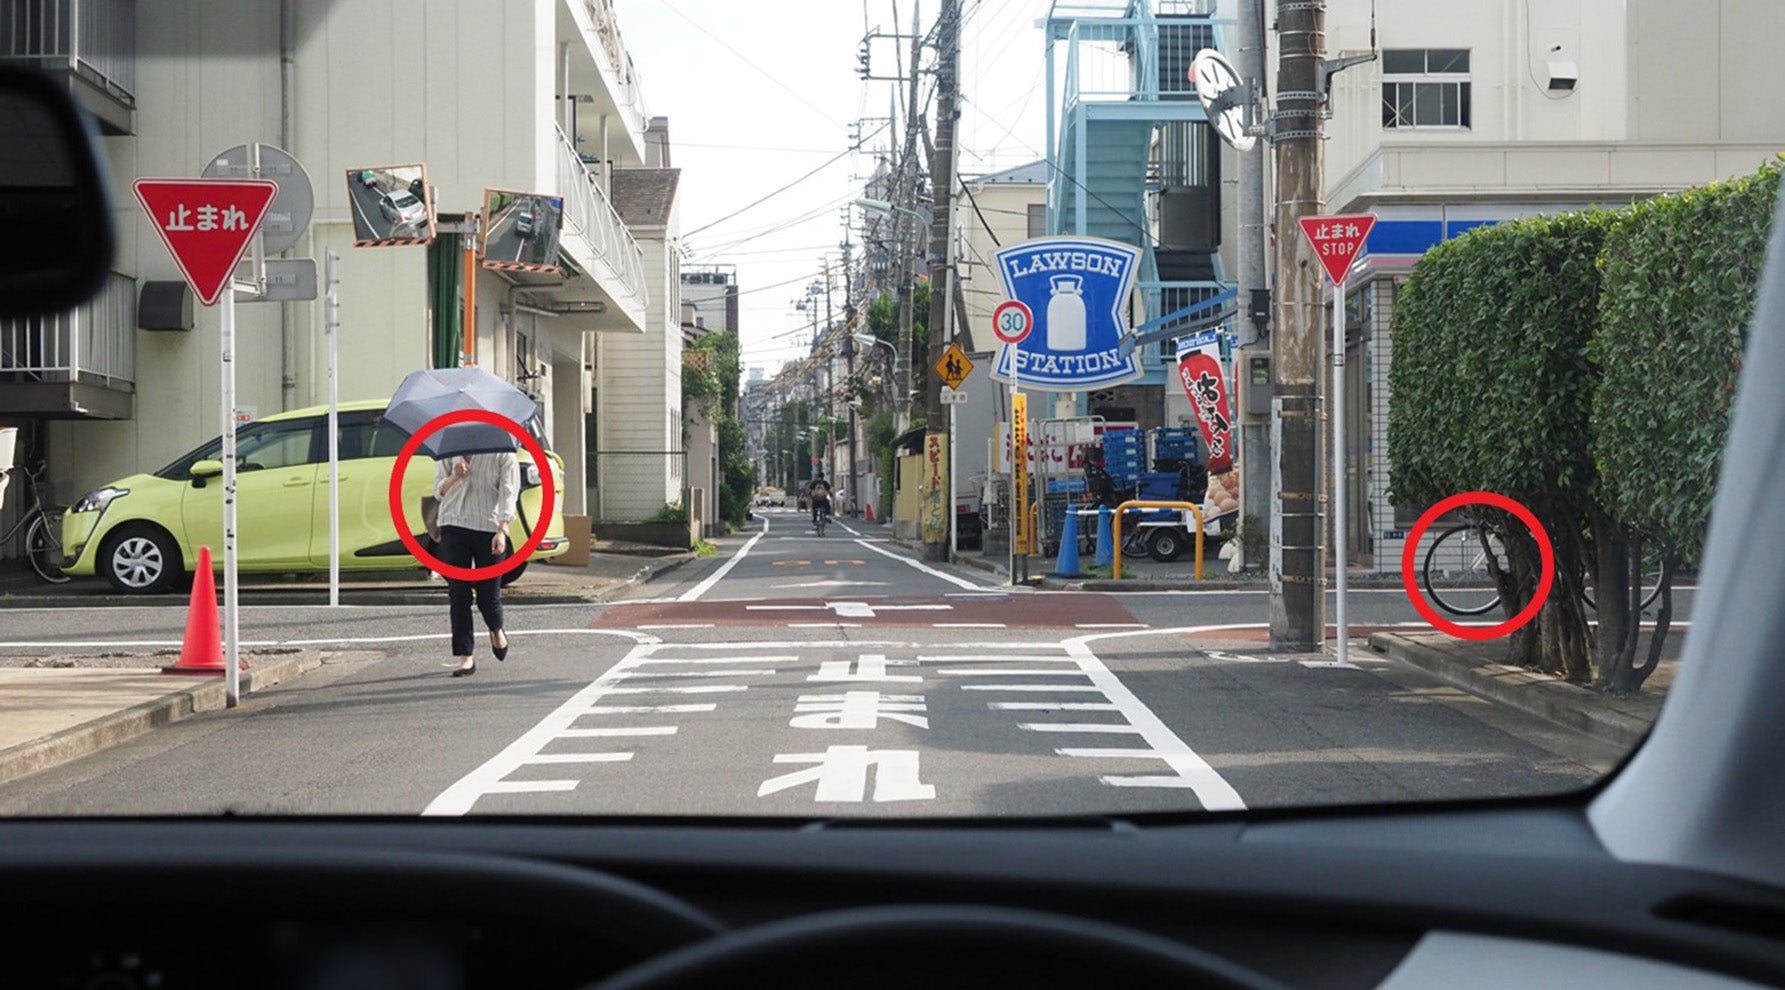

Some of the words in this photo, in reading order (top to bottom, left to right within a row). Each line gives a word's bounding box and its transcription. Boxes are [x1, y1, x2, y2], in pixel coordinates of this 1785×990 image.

[165, 203, 249, 231] 止まれ
[1314, 223, 1360, 240] 止まれ
[1322, 242, 1354, 256] STOP
[1009, 252, 1123, 278] LAWSON
[1001, 312, 1023, 332] 30
[1016, 349, 1121, 374] STATION
[757, 654, 936, 802] 止まれ
